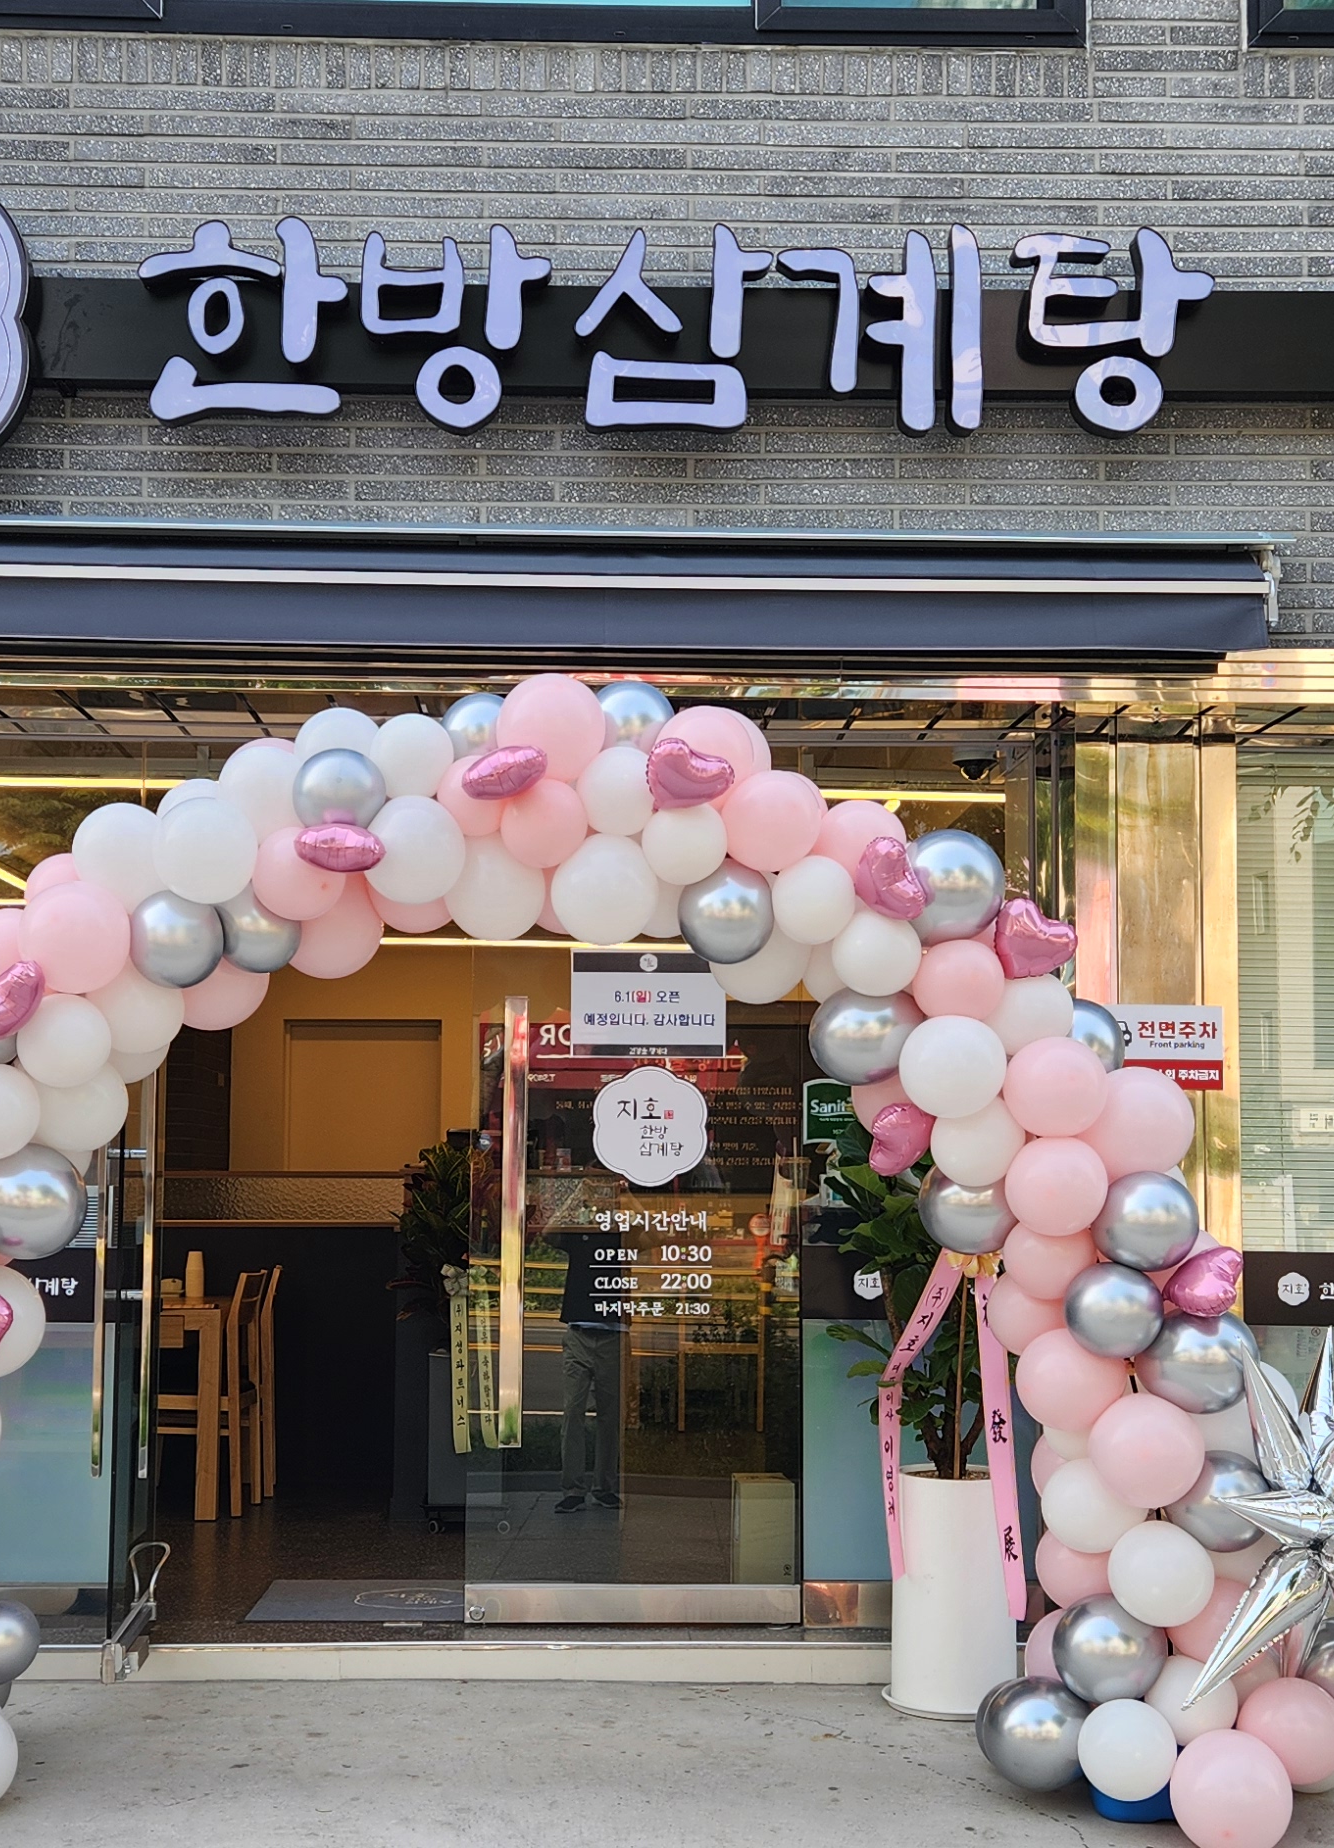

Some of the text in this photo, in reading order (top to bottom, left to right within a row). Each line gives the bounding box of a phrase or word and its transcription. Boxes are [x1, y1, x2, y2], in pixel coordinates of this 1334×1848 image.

[139, 215, 1216, 440] 한방삼계탕
[614, 990, 680, 1003] 6.1(일) 오픈
[584, 1013, 715, 1027] 예정입니다. 감사합니다
[1137, 1020, 1217, 1039] 전면주차
[1149, 1040, 1205, 1049] Front parking
[1178, 1069, 1219, 1080] 주차금지
[617, 1096, 661, 1120] 지호
[640, 1125, 668, 1139] 한방
[639, 1142, 684, 1157] 삼계탕
[595, 1211, 707, 1232] 영업시간안내
[594, 1245, 712, 1262] OPEN 10:30
[594, 1273, 712, 1290] CLOSE 22:00
[858, 1277, 880, 1289] 지호
[595, 1302, 710, 1317] 마지막주문 21:30
